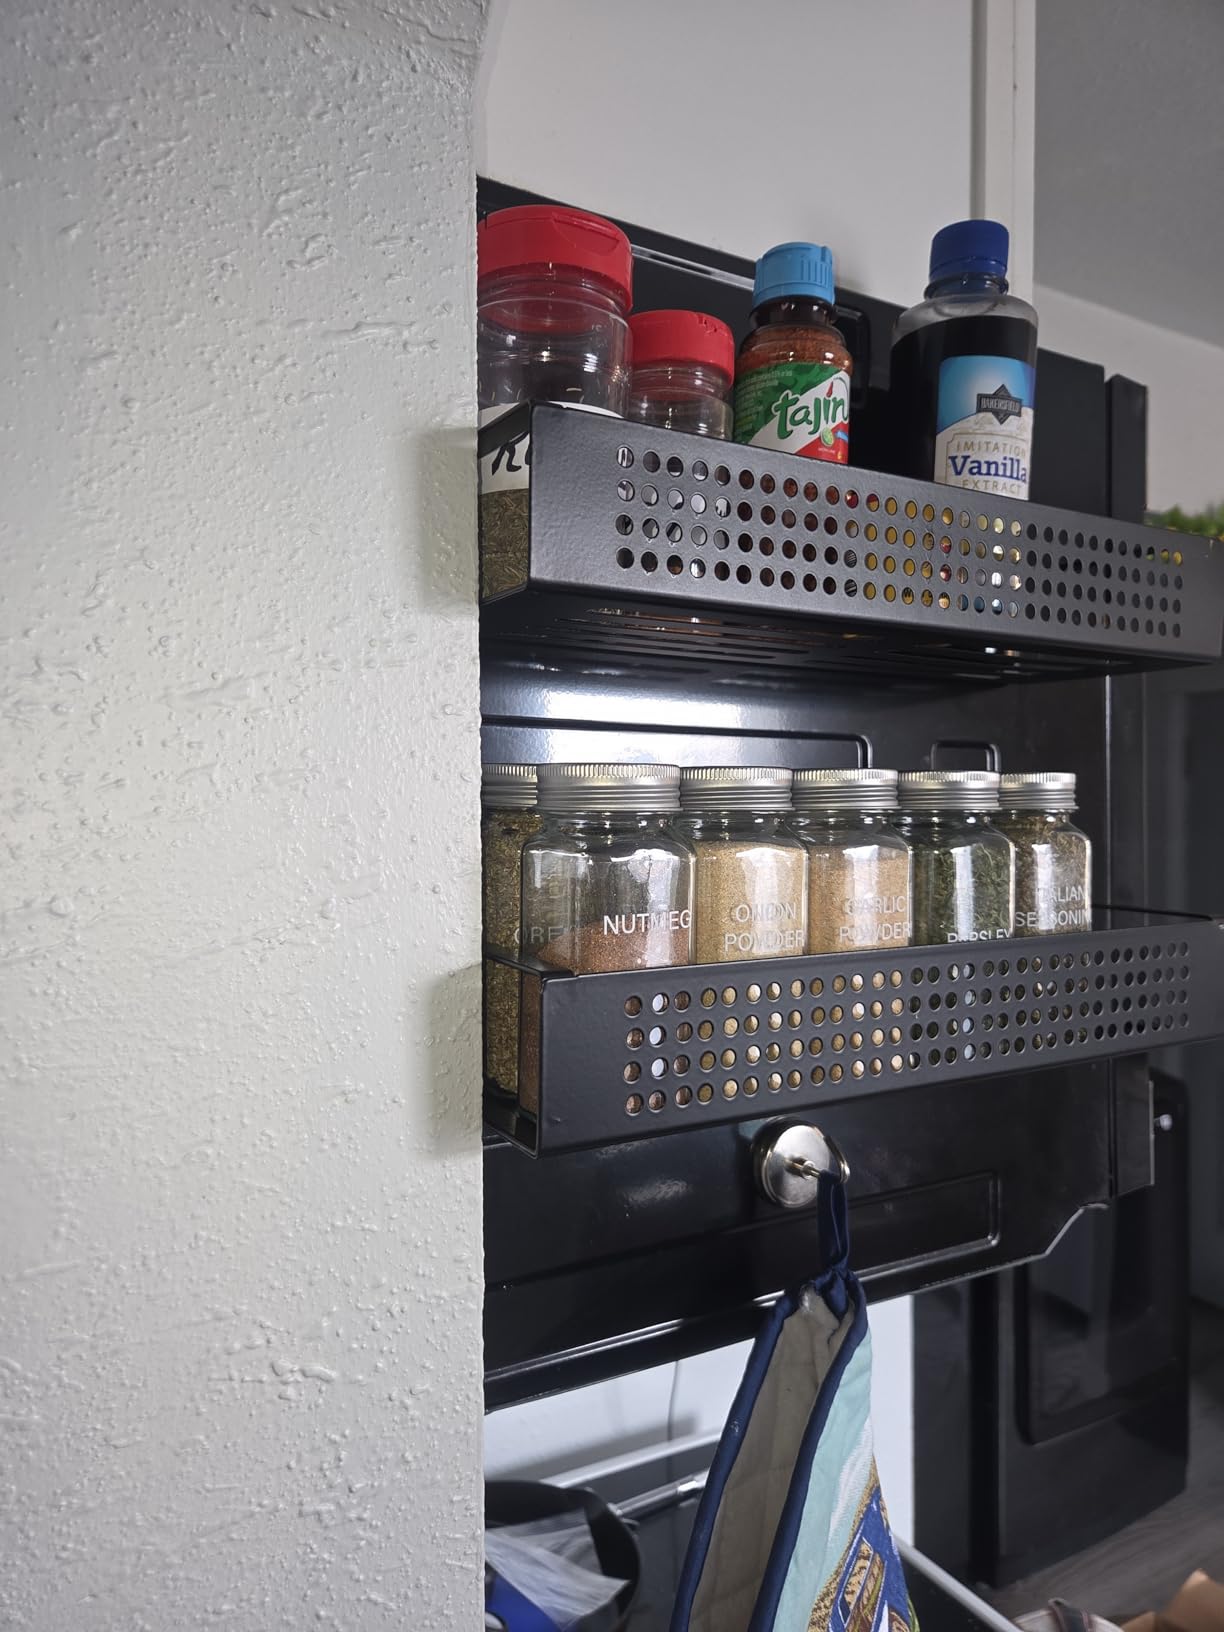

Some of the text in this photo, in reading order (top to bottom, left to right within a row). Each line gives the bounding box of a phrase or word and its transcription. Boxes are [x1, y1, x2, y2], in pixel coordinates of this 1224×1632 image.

[956, 441, 1027, 457] IMITATION
[948, 455, 1028, 485] Vanilla
[961, 479, 1022, 496] EXTRACT
[603, 909, 692, 936] NUTMEG
[735, 901, 797, 923] ONION
